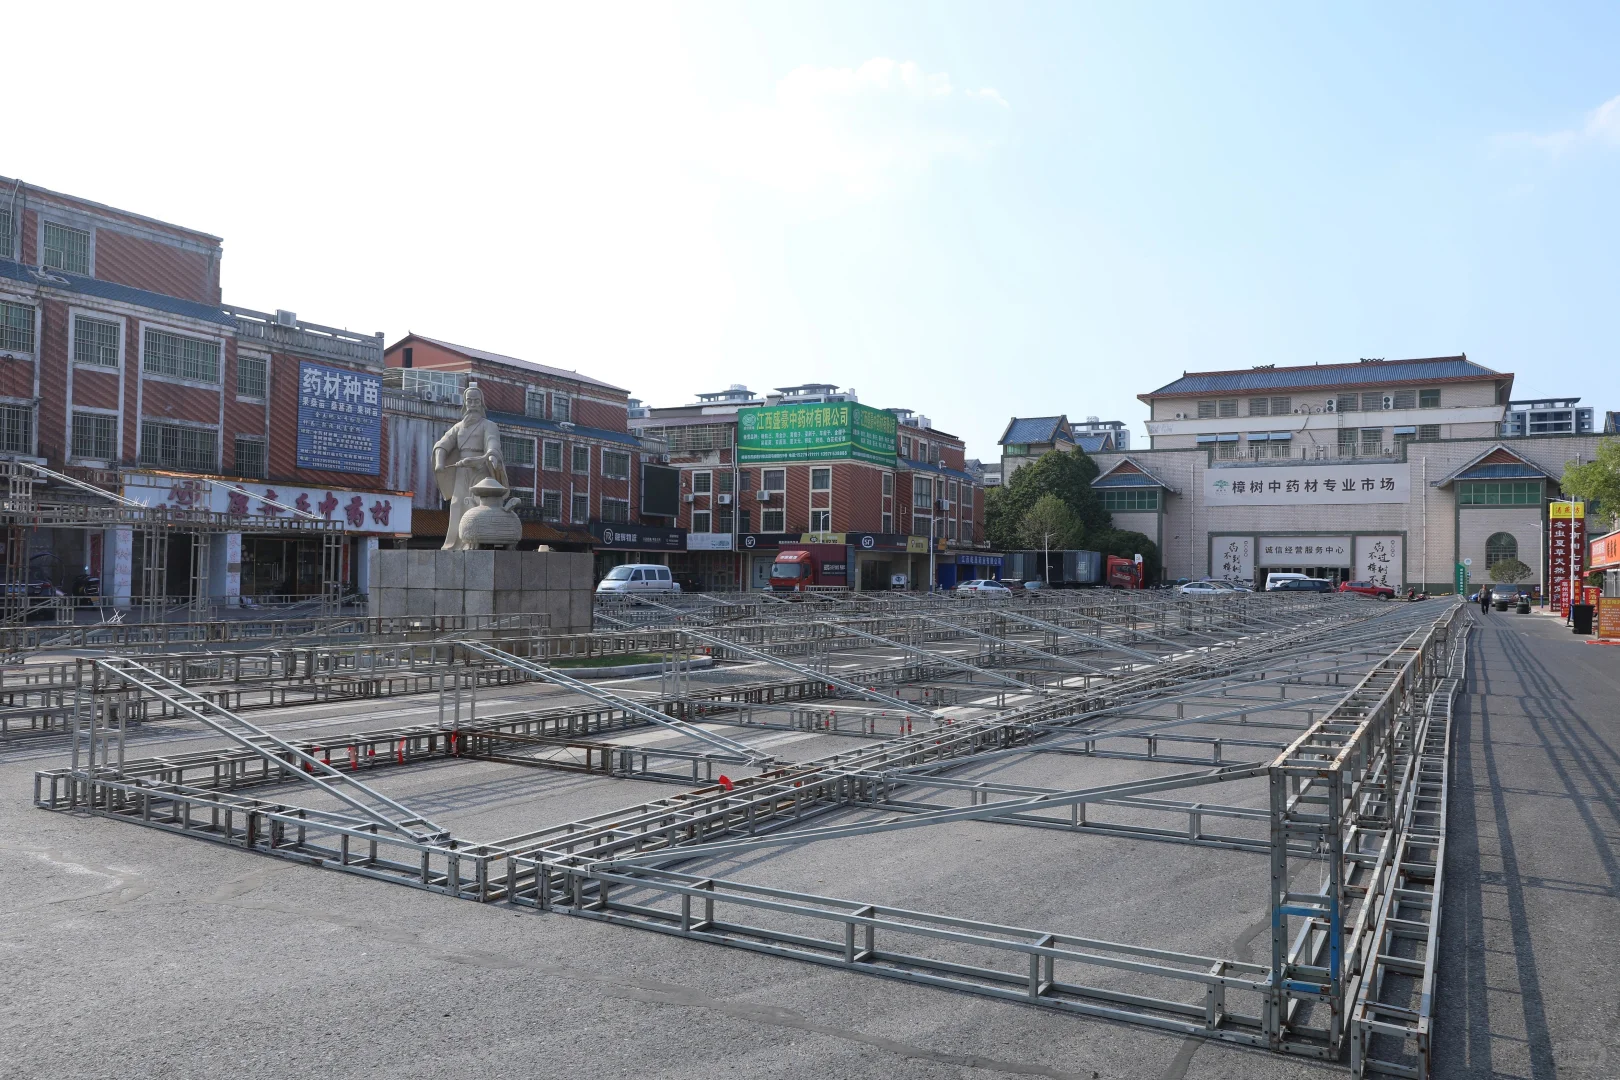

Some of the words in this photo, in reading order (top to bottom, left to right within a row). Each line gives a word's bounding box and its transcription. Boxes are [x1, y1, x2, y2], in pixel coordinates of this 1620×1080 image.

[302, 367, 380, 406] 药材种苗
[756, 407, 849, 430] 江西盛豪中药材有限公司
[1231, 477, 1396, 494] 樟树中药材专业市场
[1265, 545, 1345, 555] 诚信经营服务中心
